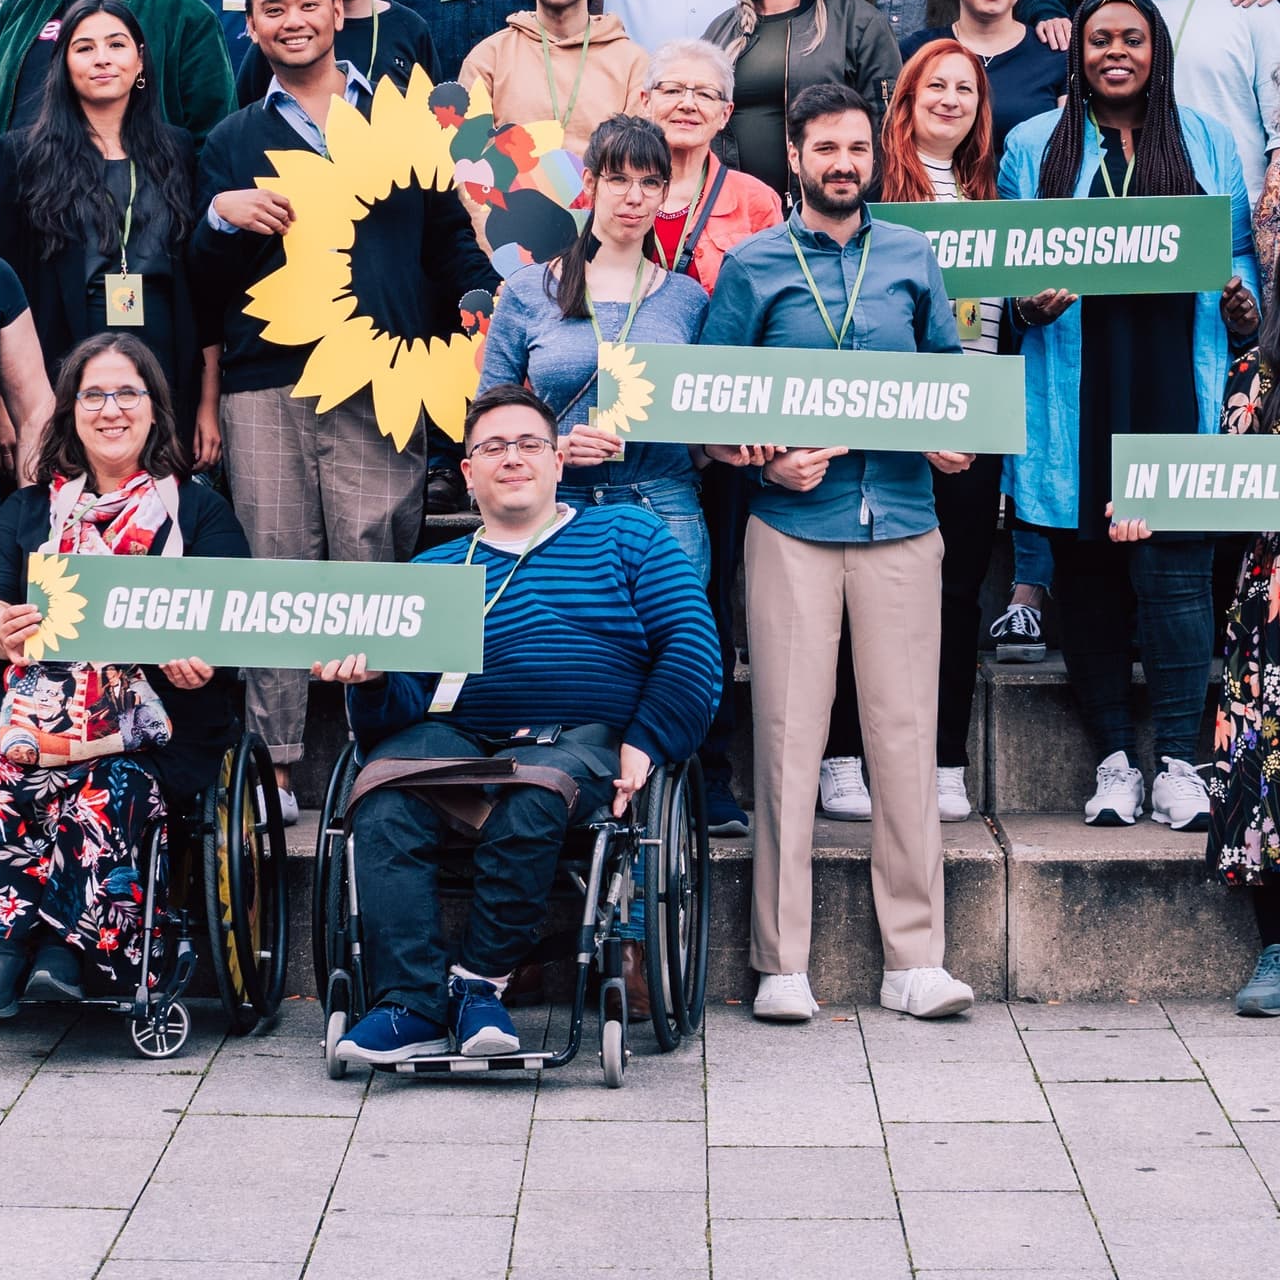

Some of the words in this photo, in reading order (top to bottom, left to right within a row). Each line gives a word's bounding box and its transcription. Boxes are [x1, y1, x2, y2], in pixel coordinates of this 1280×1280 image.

[923, 230, 997, 268] GEN
[1004, 225, 1181, 267] RASSISMUS
[670, 372, 774, 415] GEGEN
[780, 376, 971, 422] RASSISMUS
[1124, 463, 1160, 499] IN
[103, 586, 215, 631] GEGEN
[219, 590, 426, 638] RASSISMUS
